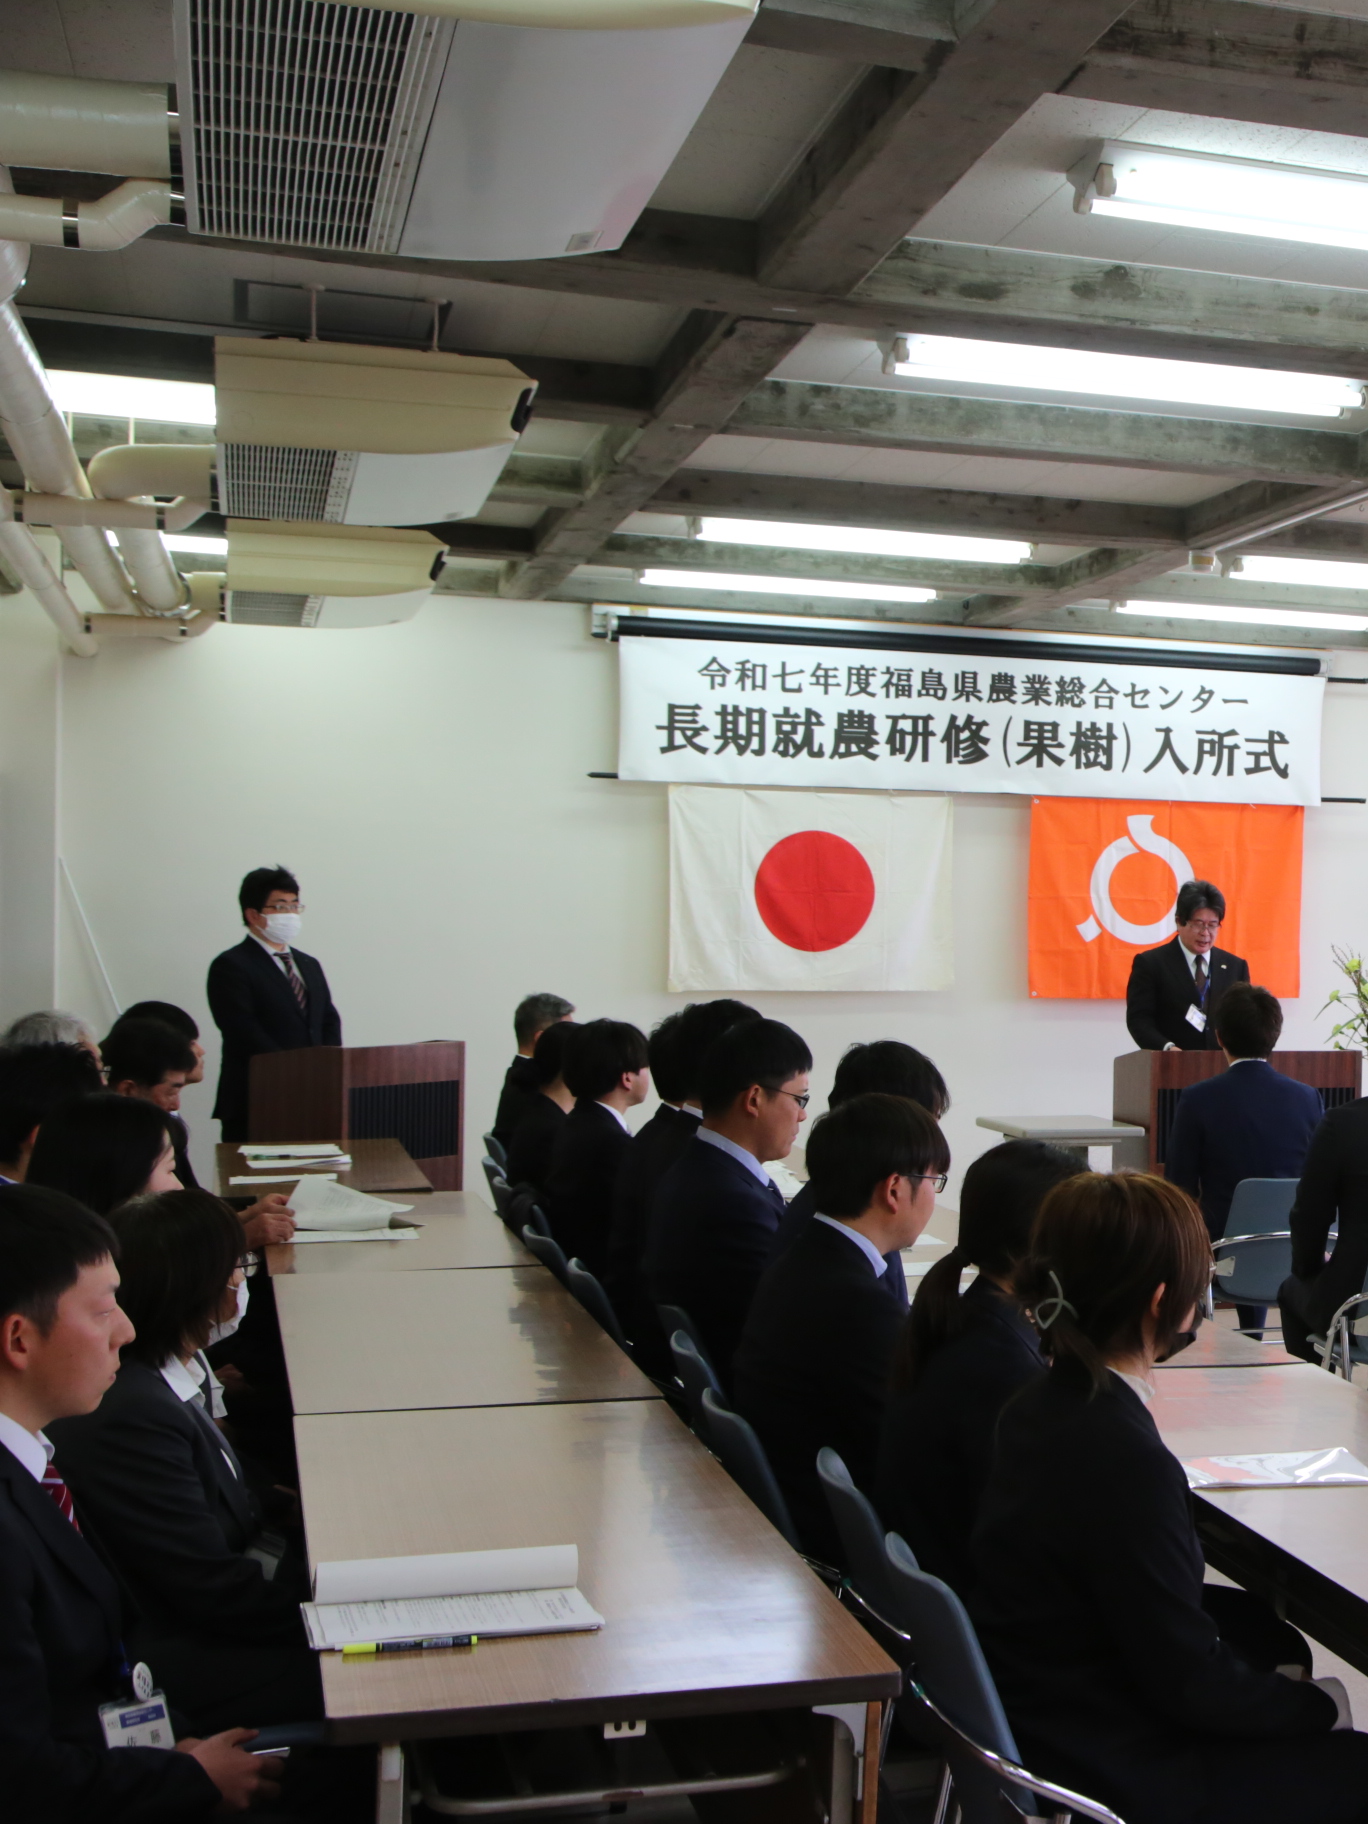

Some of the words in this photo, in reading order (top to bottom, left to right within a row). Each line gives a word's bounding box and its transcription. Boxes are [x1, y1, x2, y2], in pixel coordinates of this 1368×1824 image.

[697, 655, 1250, 714] 令和七年度福島県農業総合センター
[654, 702, 1290, 780] 長期就農研修(果樹)入所式
